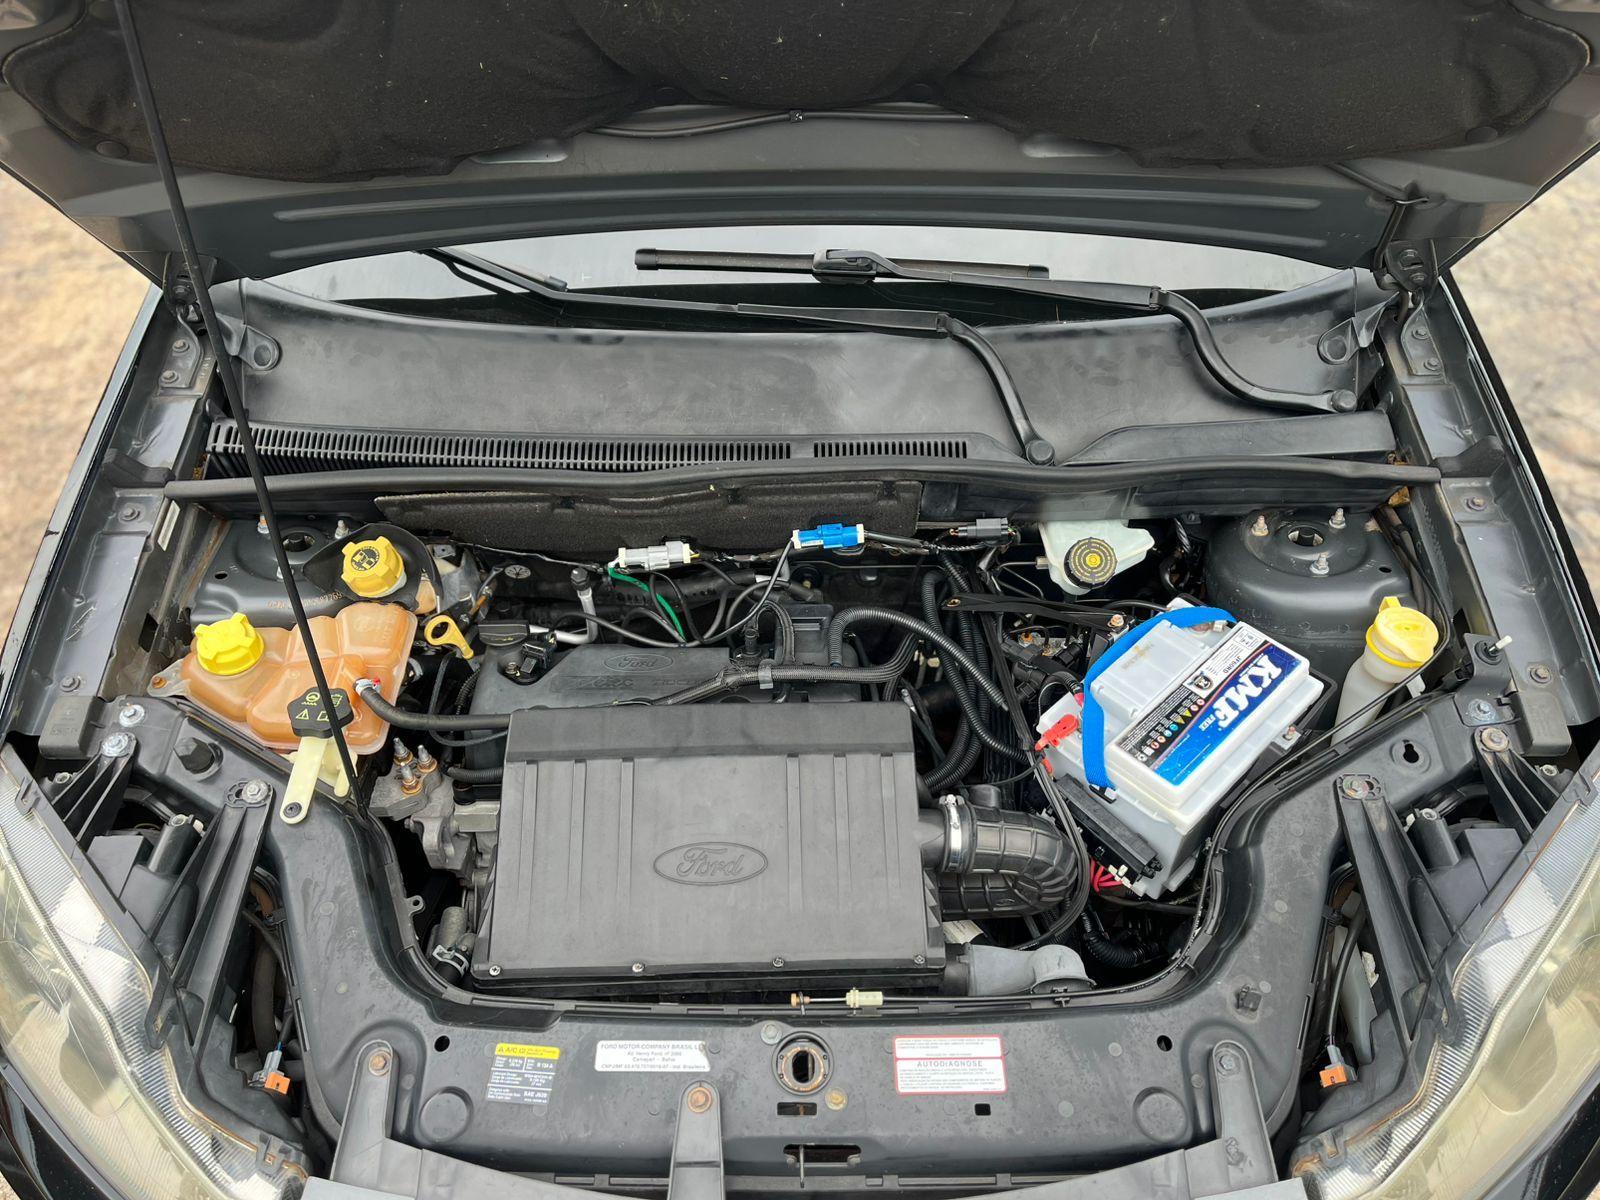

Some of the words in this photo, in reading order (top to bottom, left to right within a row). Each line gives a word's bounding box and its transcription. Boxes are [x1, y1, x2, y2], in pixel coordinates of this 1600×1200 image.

[617, 655, 657, 670] Ford
[1213, 653, 1282, 729] KMF
[1198, 713, 1216, 732] FREE
[676, 846, 745, 878] Ford
[916, 1060, 983, 1068] AUTODIAGNOSE
